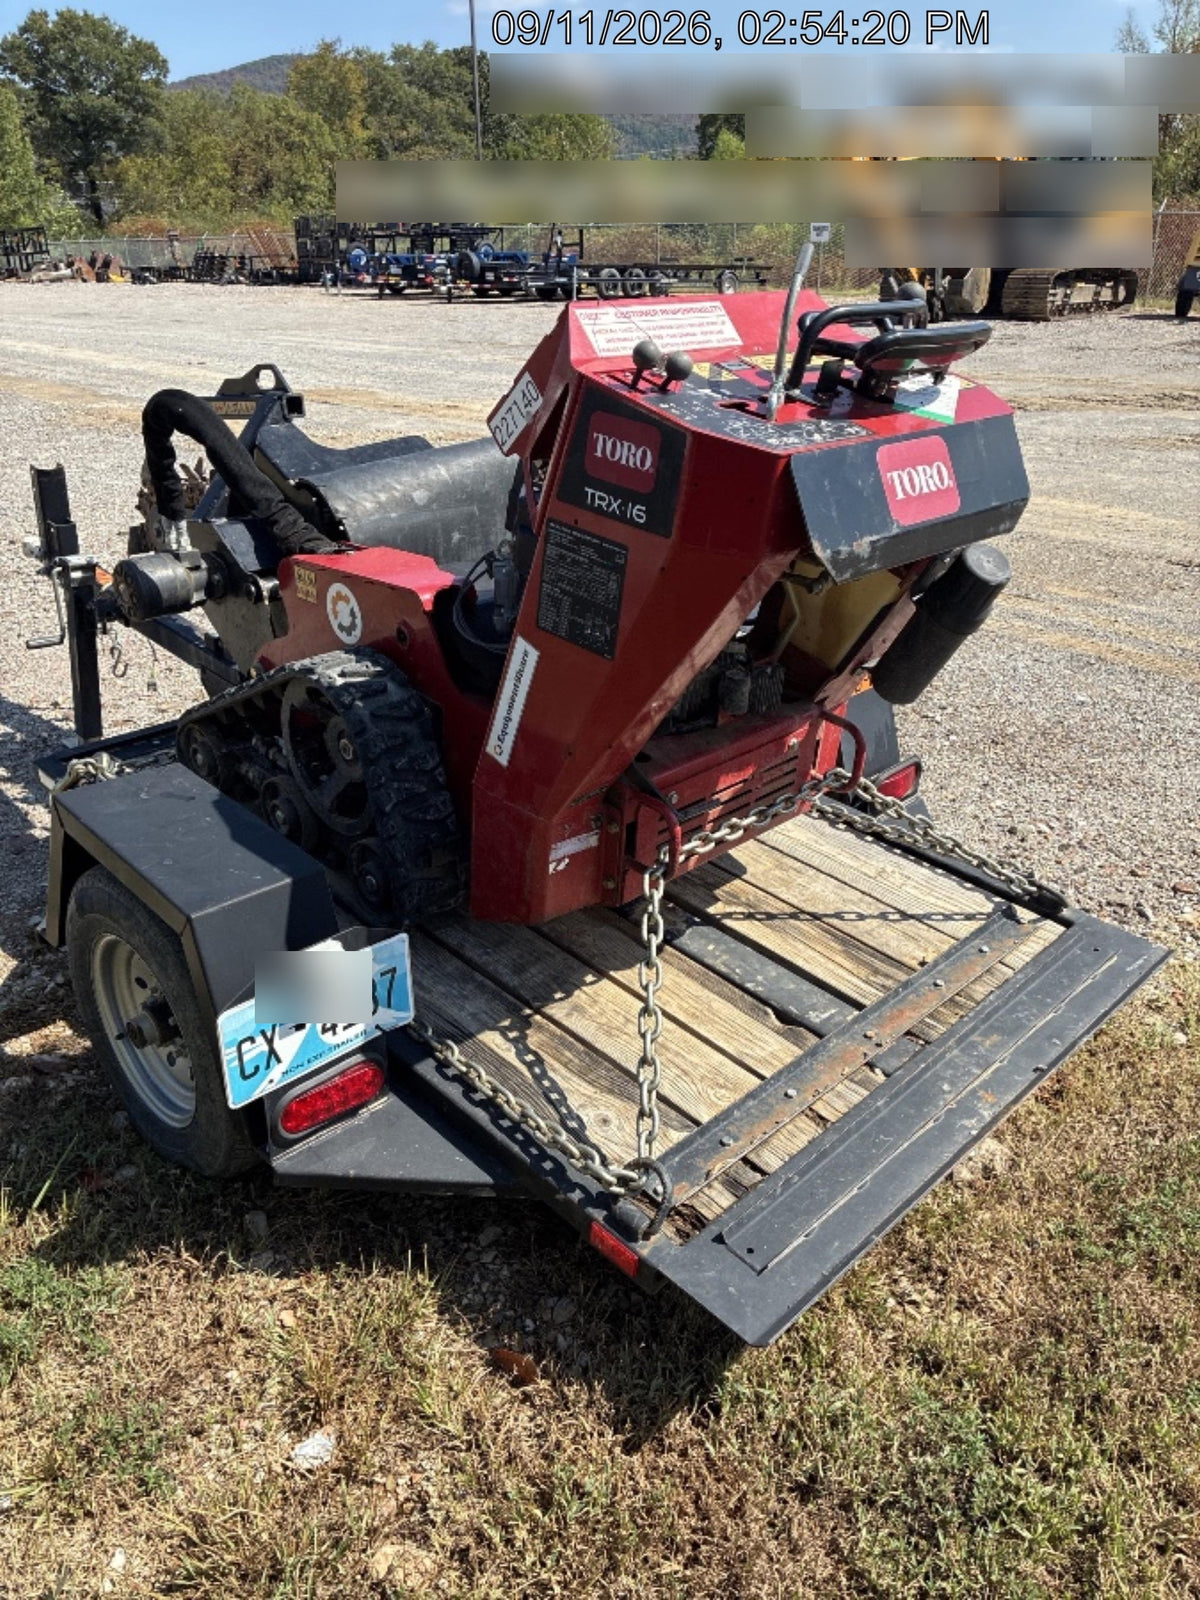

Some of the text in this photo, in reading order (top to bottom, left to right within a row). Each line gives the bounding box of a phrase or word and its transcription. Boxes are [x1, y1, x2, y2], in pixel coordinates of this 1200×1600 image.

[494, 379, 540, 447] 227140
[592, 431, 653, 472] TORO
[886, 460, 951, 501] TORO
[235, 1023, 283, 1082] CX
[281, 1063, 305, 1078] NON
